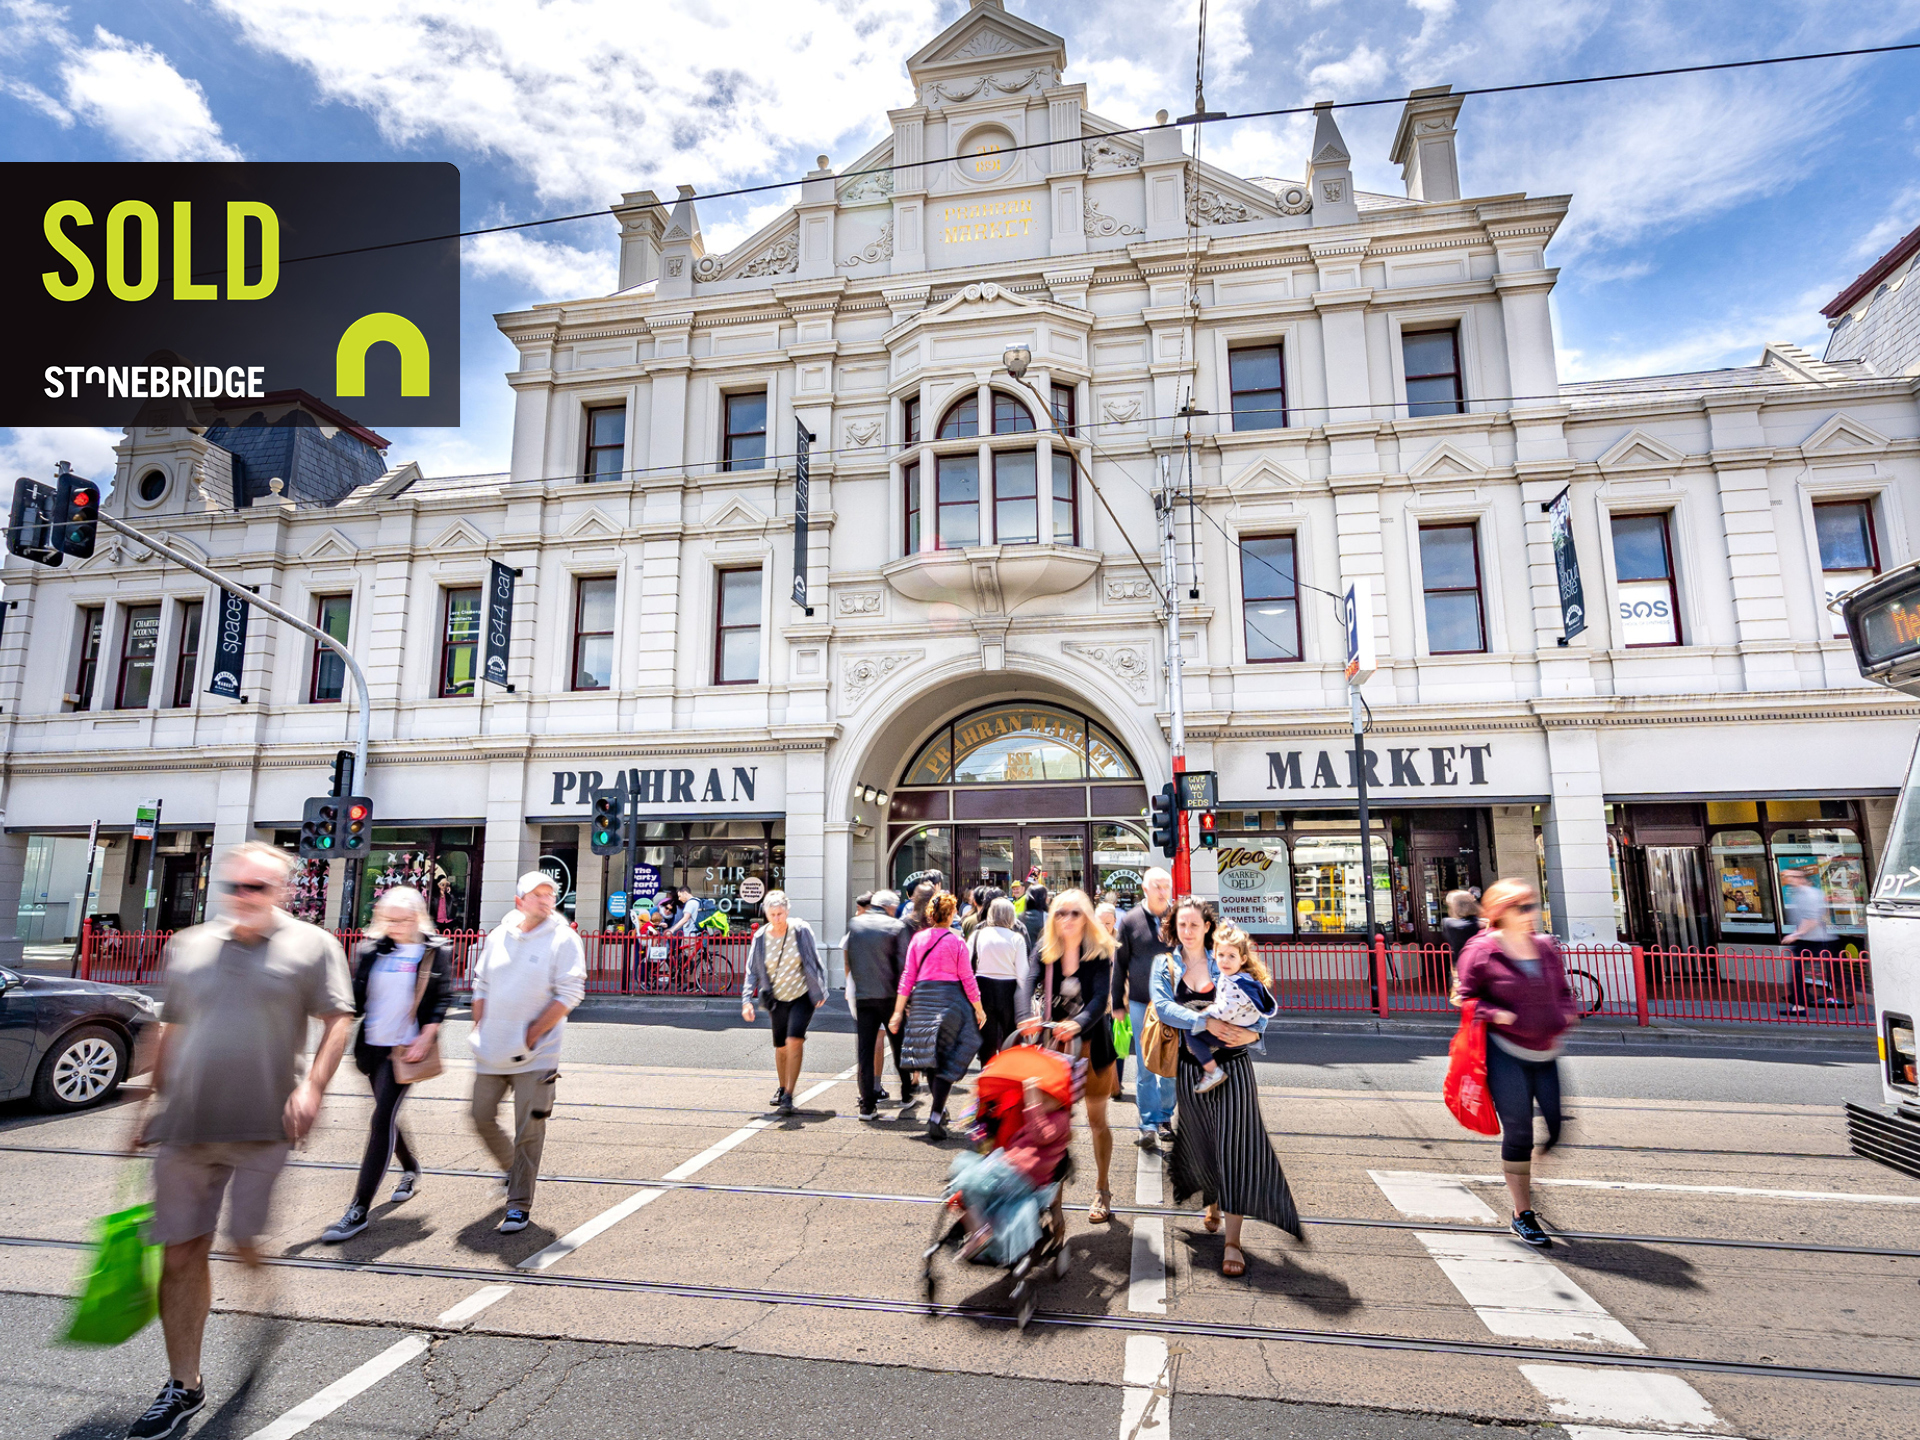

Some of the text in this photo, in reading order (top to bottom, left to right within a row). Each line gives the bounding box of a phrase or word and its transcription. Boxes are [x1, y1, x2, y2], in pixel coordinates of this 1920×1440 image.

[975, 159, 1001, 173] 1891
[944, 199, 1032, 222] PRAHRAN
[944, 218, 1033, 244] MARKET
[796, 429, 809, 524] Market
[490, 567, 511, 648] 644 car
[1620, 600, 1668, 619] SOS
[1346, 597, 1355, 653] P
[1892, 603, 1920, 643] Me
[925, 715, 1117, 775] PRAHRAN MARKET
[1007, 752, 1033, 767] EST
[1266, 743, 1492, 790] MARKET
[551, 767, 758, 805] PRAHRAN
[1188, 775, 1206, 783] GIVE
[1189, 783, 1206, 791] WAY
[1187, 799, 1209, 807] PEDS
[1192, 791, 1203, 799] TO
[705, 866, 745, 881] STIR
[1228, 871, 1259, 879] MARKET
[1830, 866, 1850, 888] 4
[713, 884, 736, 895] THE
[1231, 879, 1255, 890] DELI
